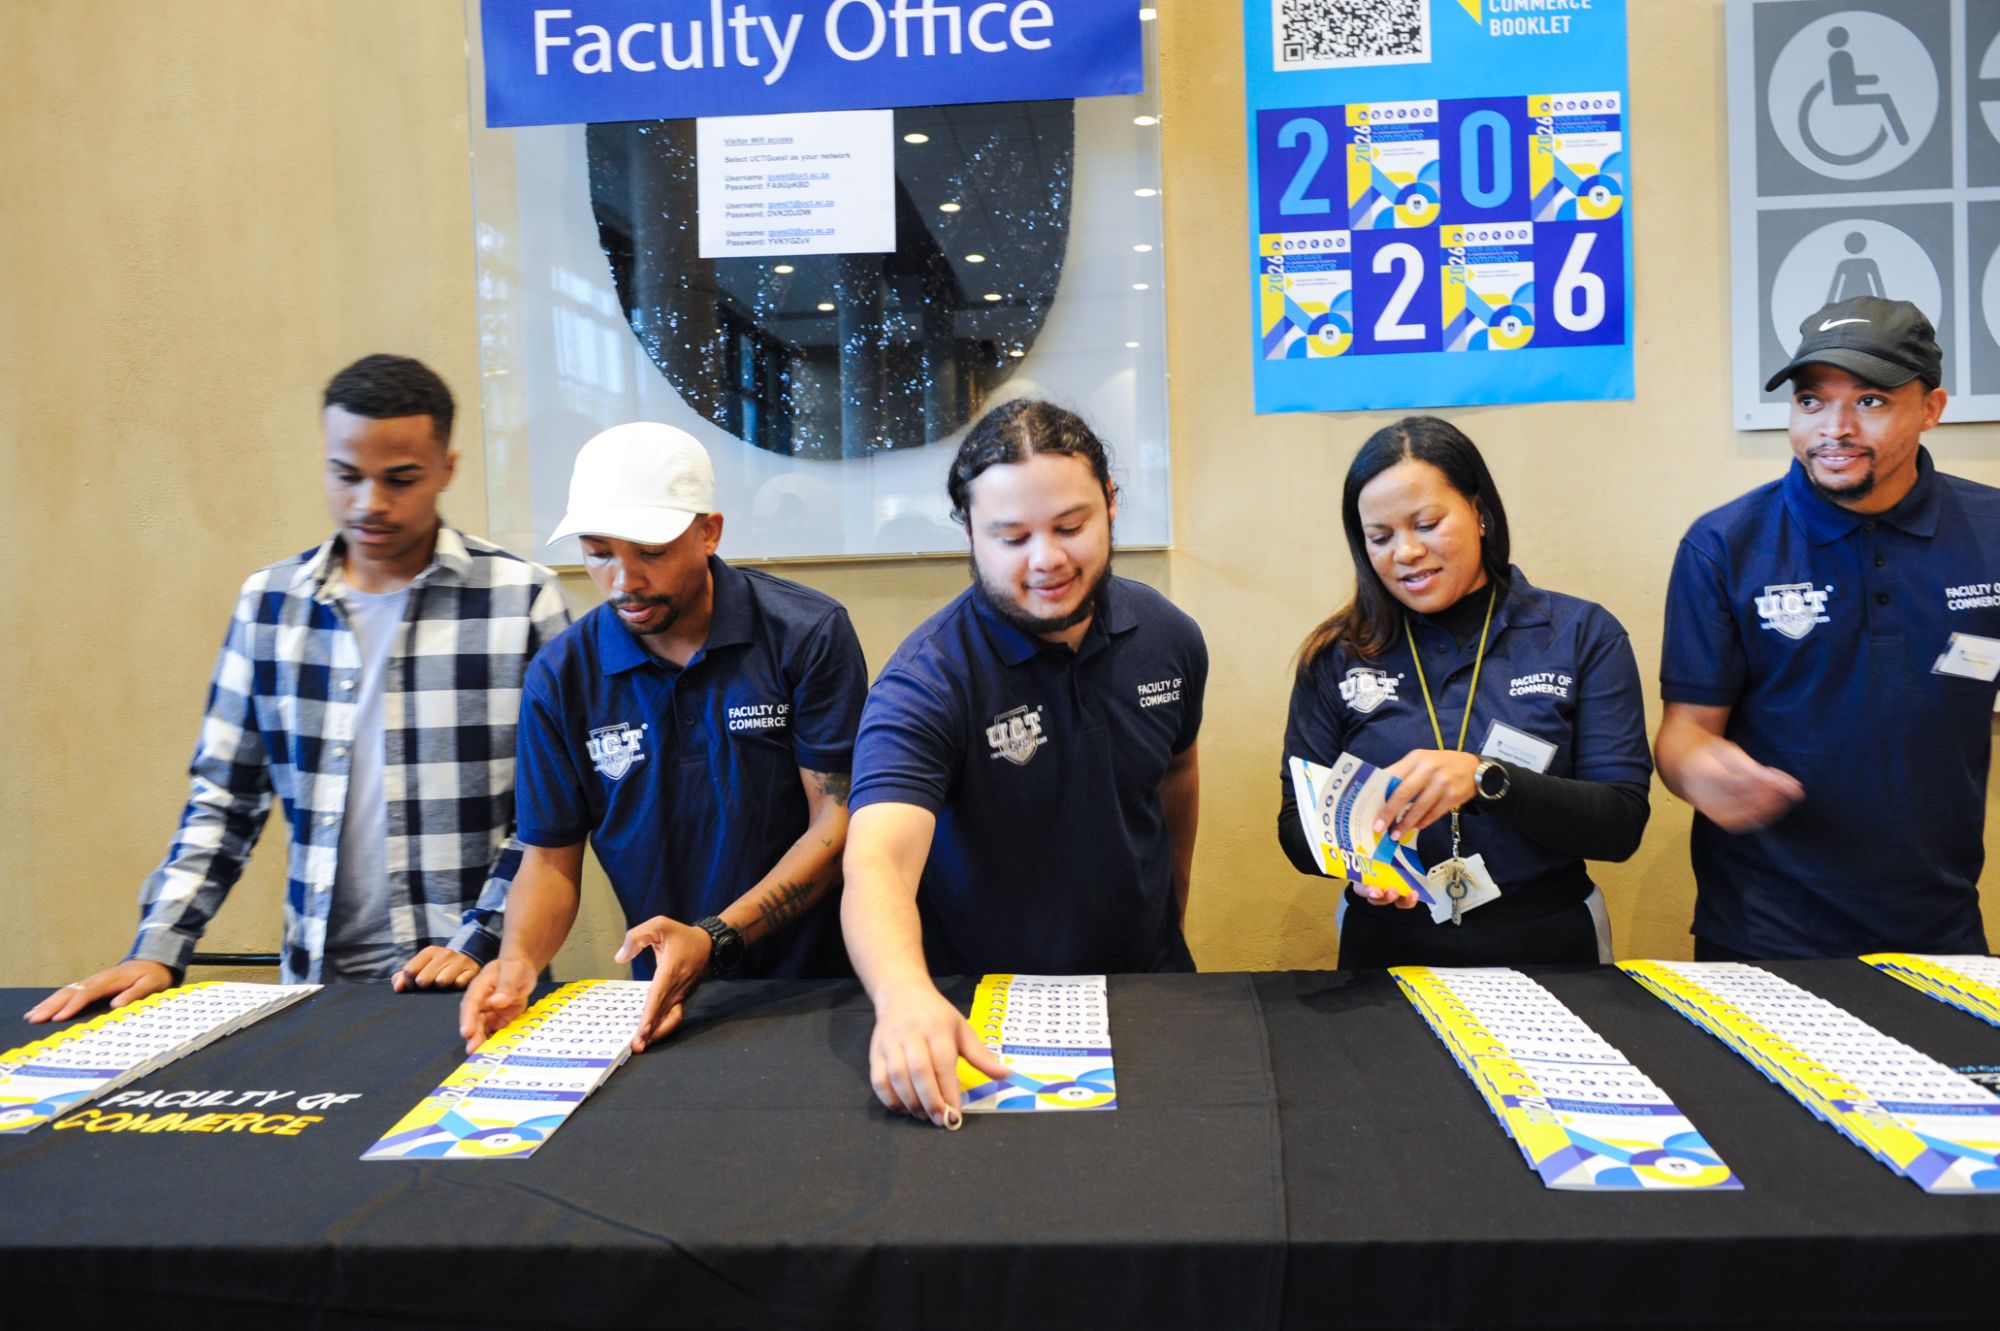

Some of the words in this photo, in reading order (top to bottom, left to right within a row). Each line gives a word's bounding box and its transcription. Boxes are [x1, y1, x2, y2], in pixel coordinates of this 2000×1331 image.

[1489, 15, 1572, 37] BOOKLET
[533, 0, 804, 86] Faculty
[824, 0, 1055, 62] Office
[724, 138, 748, 146] Visitor
[1353, 125, 1371, 163] 2026
[1535, 116, 1553, 154] 2026
[725, 155, 748, 163] Select
[820, 152, 851, 160] network
[1277, 117, 1331, 216] 2
[1459, 109, 1513, 209] 0
[1267, 255, 1284, 294] 2026
[1448, 247, 1466, 285] 2026
[1371, 242, 1426, 342] 2
[1552, 232, 1606, 333] 6
[1945, 583, 1991, 598] FACULTY
[1993, 582, 2000, 594] O
[1754, 590, 1829, 619] UCT
[1947, 595, 2000, 611] COMMERC
[1137, 680, 1171, 696] FACULTY
[1172, 677, 1183, 688] OF
[1509, 684, 1569, 698] COMMERCE
[1510, 672, 1555, 687] FACULTY
[1557, 674, 1573, 687] OF
[728, 704, 773, 718] FACULTY
[777, 703, 790, 714] OF
[1139, 690, 1180, 708] COMMERCE
[728, 716, 786, 731] COMMERCE
[986, 711, 1043, 749] UCT
[585, 729, 643, 761] UCT
[97, 1090, 296, 1108] FACULTY
[297, 1093, 363, 1110] OF
[53, 1109, 325, 1136] COMMERCE
